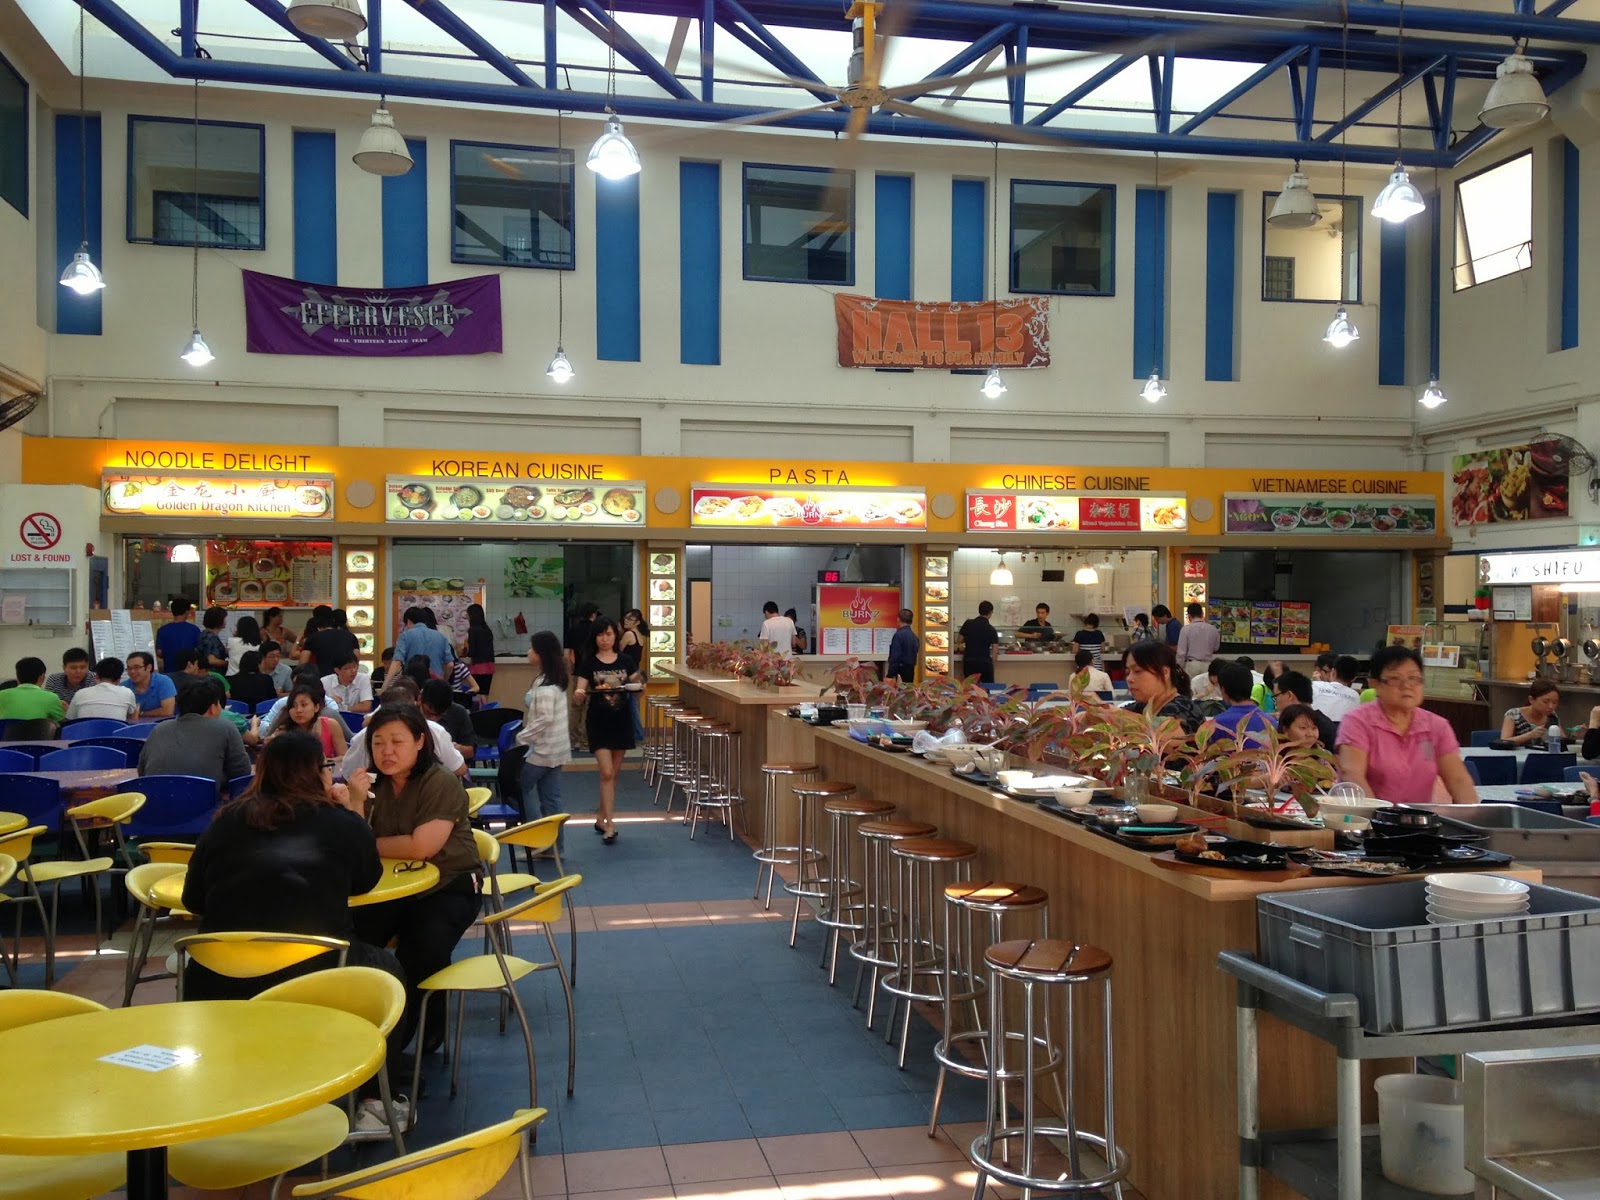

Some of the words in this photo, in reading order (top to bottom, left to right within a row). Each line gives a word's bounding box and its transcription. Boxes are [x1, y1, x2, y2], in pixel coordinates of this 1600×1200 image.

[299, 301, 455, 327] EFFERVESCE
[349, 326, 381, 337] HALL
[385, 326, 408, 338] XIII
[851, 310, 972, 353] HALL
[977, 312, 1025, 353] 13
[851, 350, 924, 365] WELCOME
[925, 351, 945, 365] TO
[945, 350, 973, 365] OUR
[973, 351, 1025, 365] FAMILY
[125, 450, 215, 470] NOODLE
[223, 453, 311, 472] DELIGHT
[431, 460, 520, 478] KOREAN
[526, 462, 604, 481] CUISINE
[769, 468, 850, 486] PASTA
[1002, 474, 1077, 491] CHINESE
[1083, 475, 1151, 492] CUISINE
[1251, 477, 1348, 494] VIETNAMESE
[1351, 479, 1408, 495] CUISINE
[156, 499, 197, 511] Golden
[201, 500, 243, 515] Dragon
[247, 500, 291, 513] Kitchen
[10, 553, 32, 562] LOST
[34, 554, 41, 562] &
[42, 554, 71, 562] FOUND
[824, 572, 839, 582] 86
[1532, 560, 1583, 577] SHIFU
[842, 610, 880, 619] BURNZ
